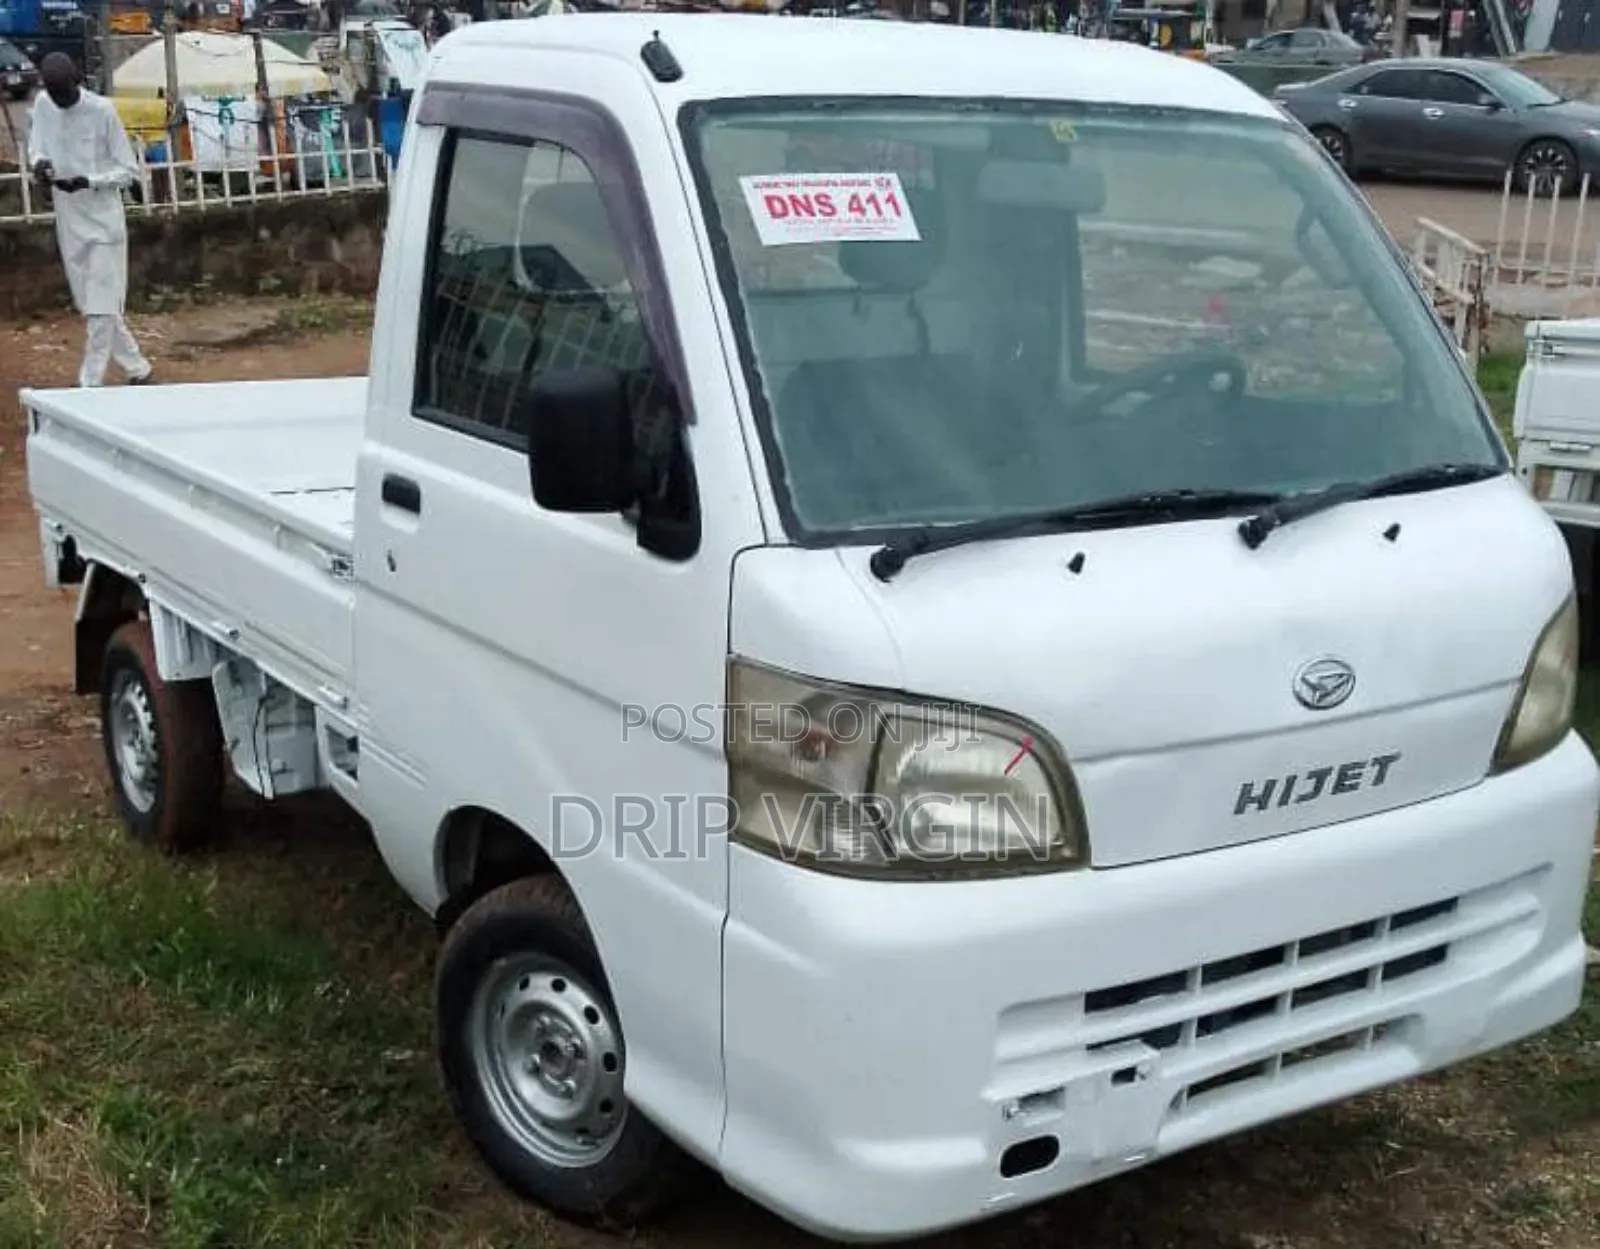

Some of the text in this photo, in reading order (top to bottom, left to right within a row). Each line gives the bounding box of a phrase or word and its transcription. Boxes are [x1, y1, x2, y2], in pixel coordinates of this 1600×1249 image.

[764, 192, 901, 219] DNS 411
[1234, 752, 1402, 815] HIJET
